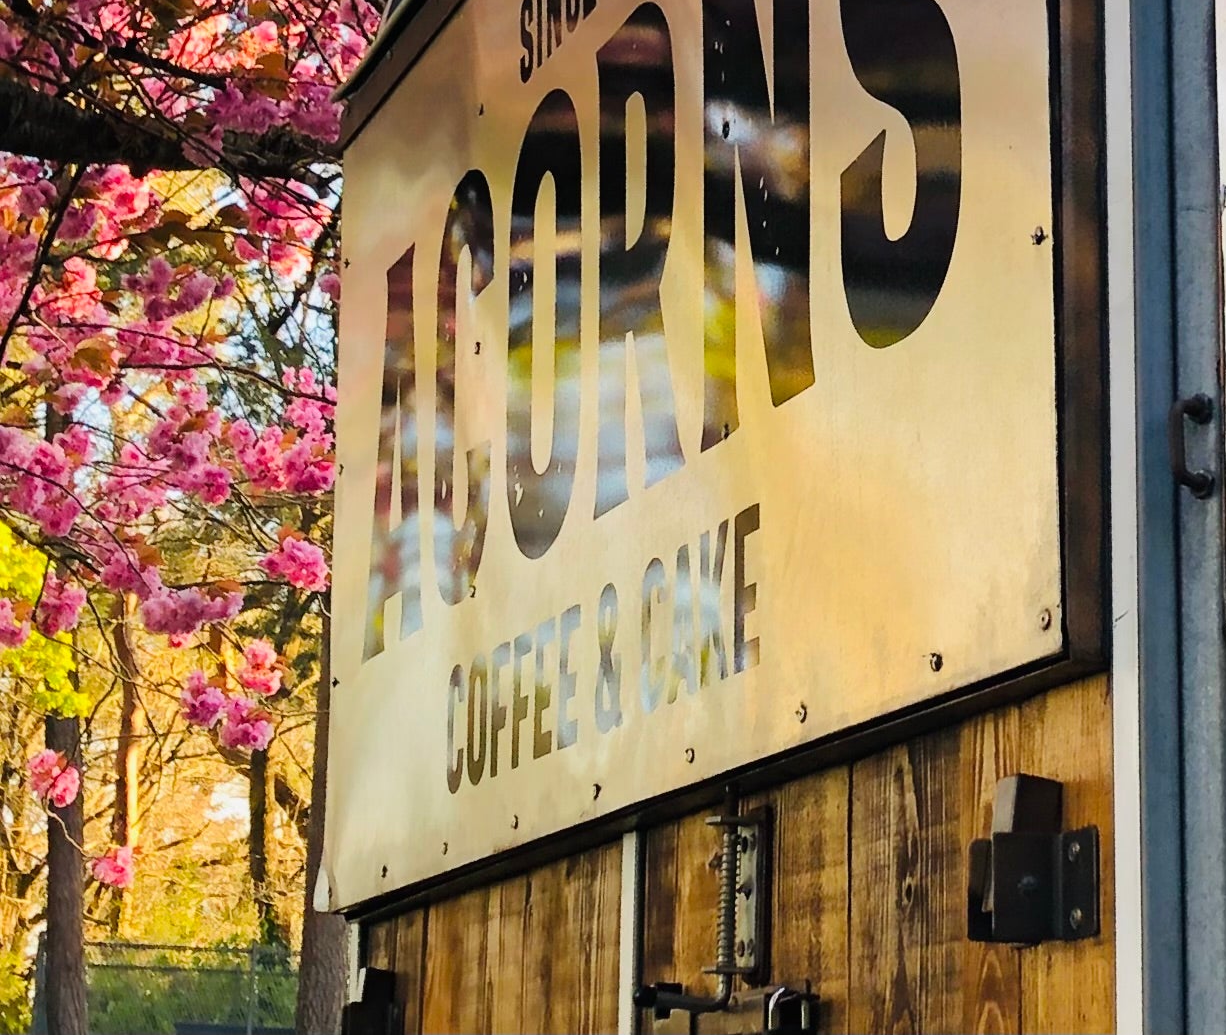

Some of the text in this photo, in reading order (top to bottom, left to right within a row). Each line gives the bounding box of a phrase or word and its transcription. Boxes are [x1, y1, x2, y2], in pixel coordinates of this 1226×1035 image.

[447, 503, 760, 795] COFFEE & CAKE
